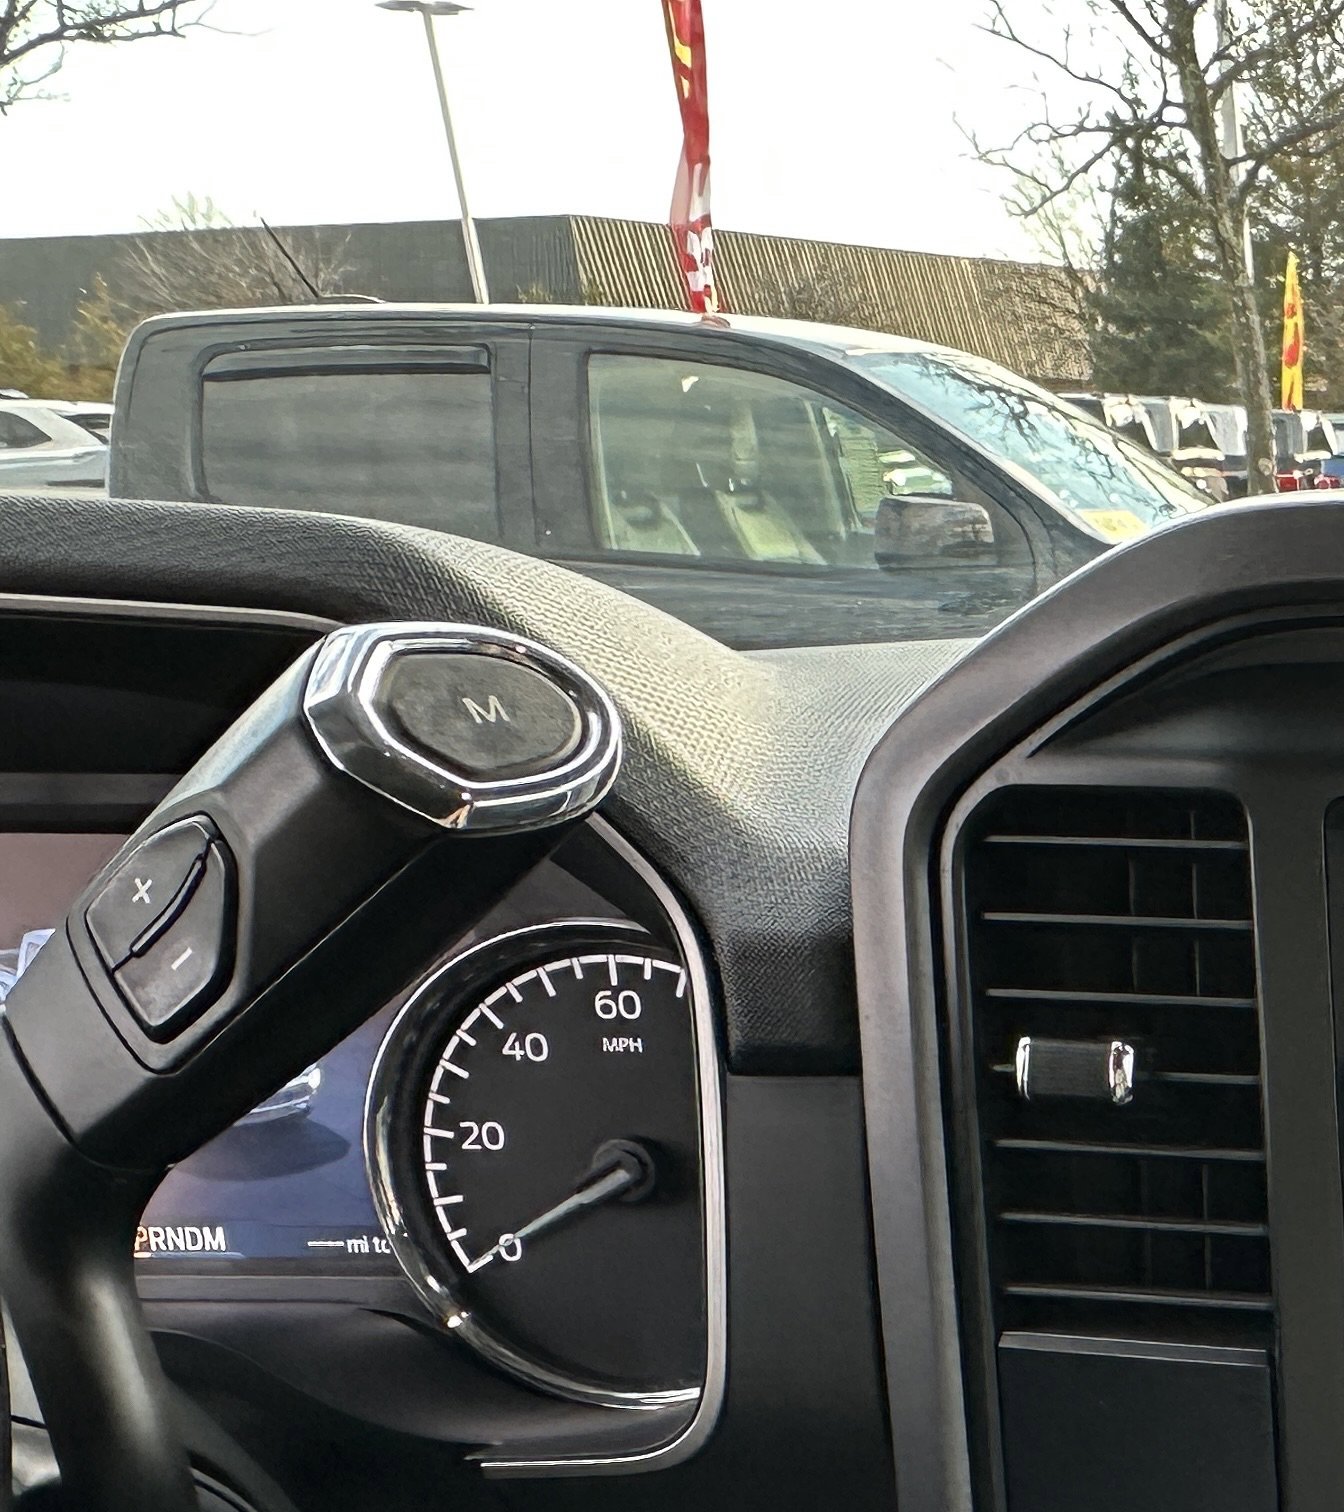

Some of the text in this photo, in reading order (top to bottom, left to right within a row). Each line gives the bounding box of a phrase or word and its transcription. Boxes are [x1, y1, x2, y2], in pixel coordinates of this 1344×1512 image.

[461, 694, 511, 724] M
[594, 990, 642, 1020] 60
[501, 1032, 549, 1062] 40
[602, 1037, 643, 1053] MPH
[459, 1121, 505, 1151] 20
[498, 1232, 523, 1262] 0
